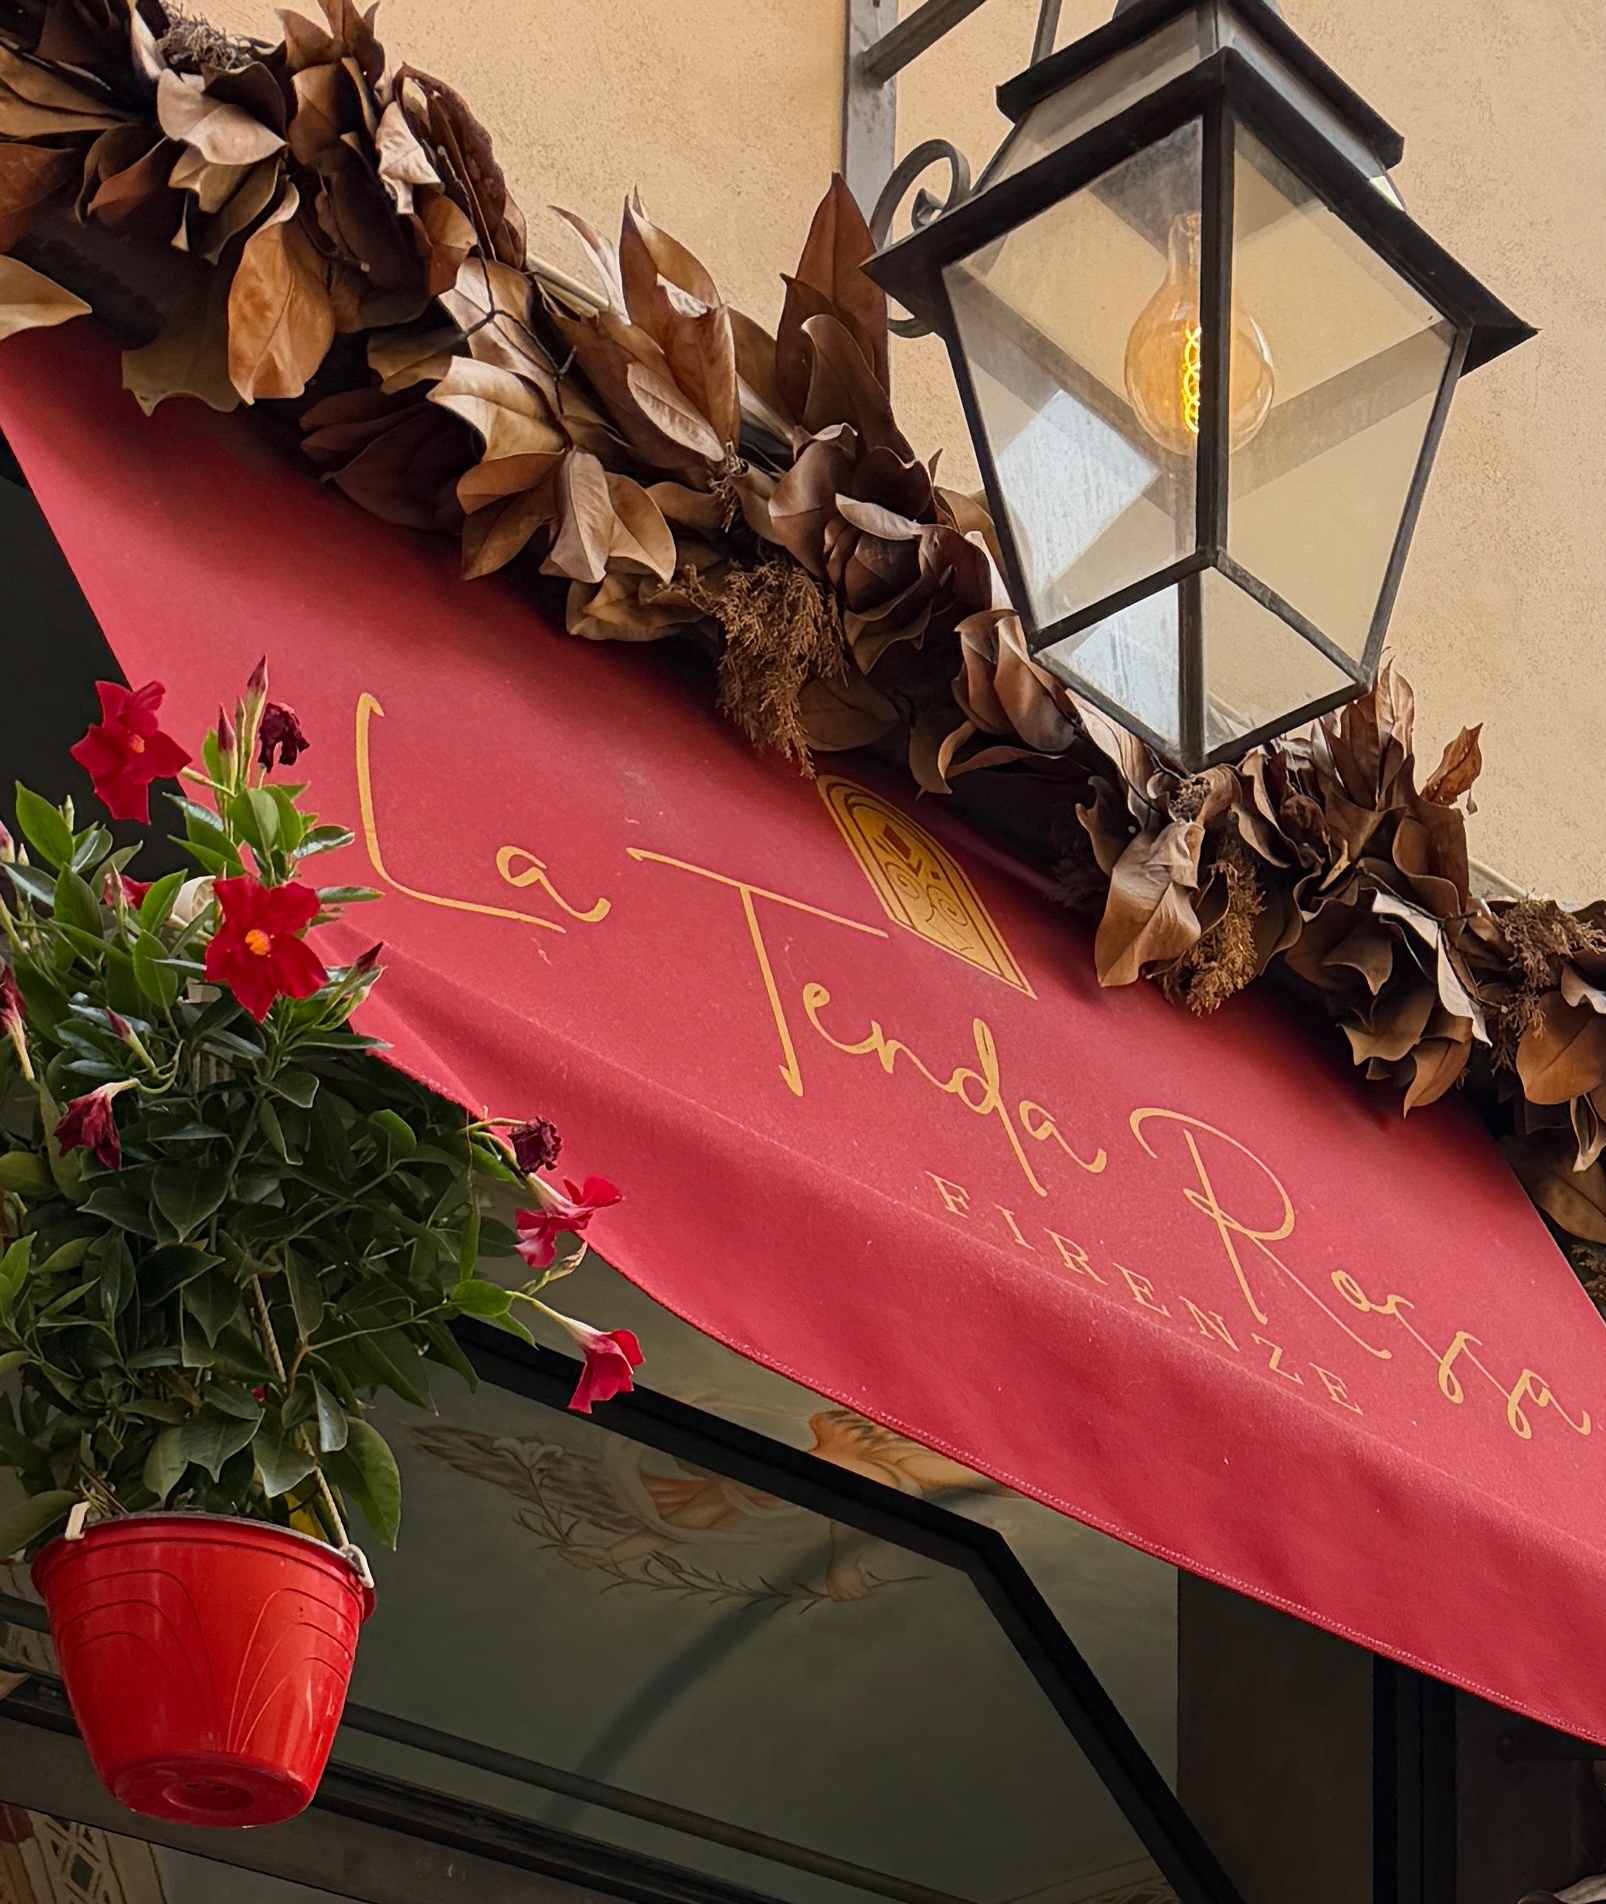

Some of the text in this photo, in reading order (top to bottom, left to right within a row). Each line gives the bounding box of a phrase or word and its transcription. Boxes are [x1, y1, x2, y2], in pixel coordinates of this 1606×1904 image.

[355, 691, 1593, 1441] La Tenda Rossa
[925, 1168, 1365, 1418] FIRENZE
